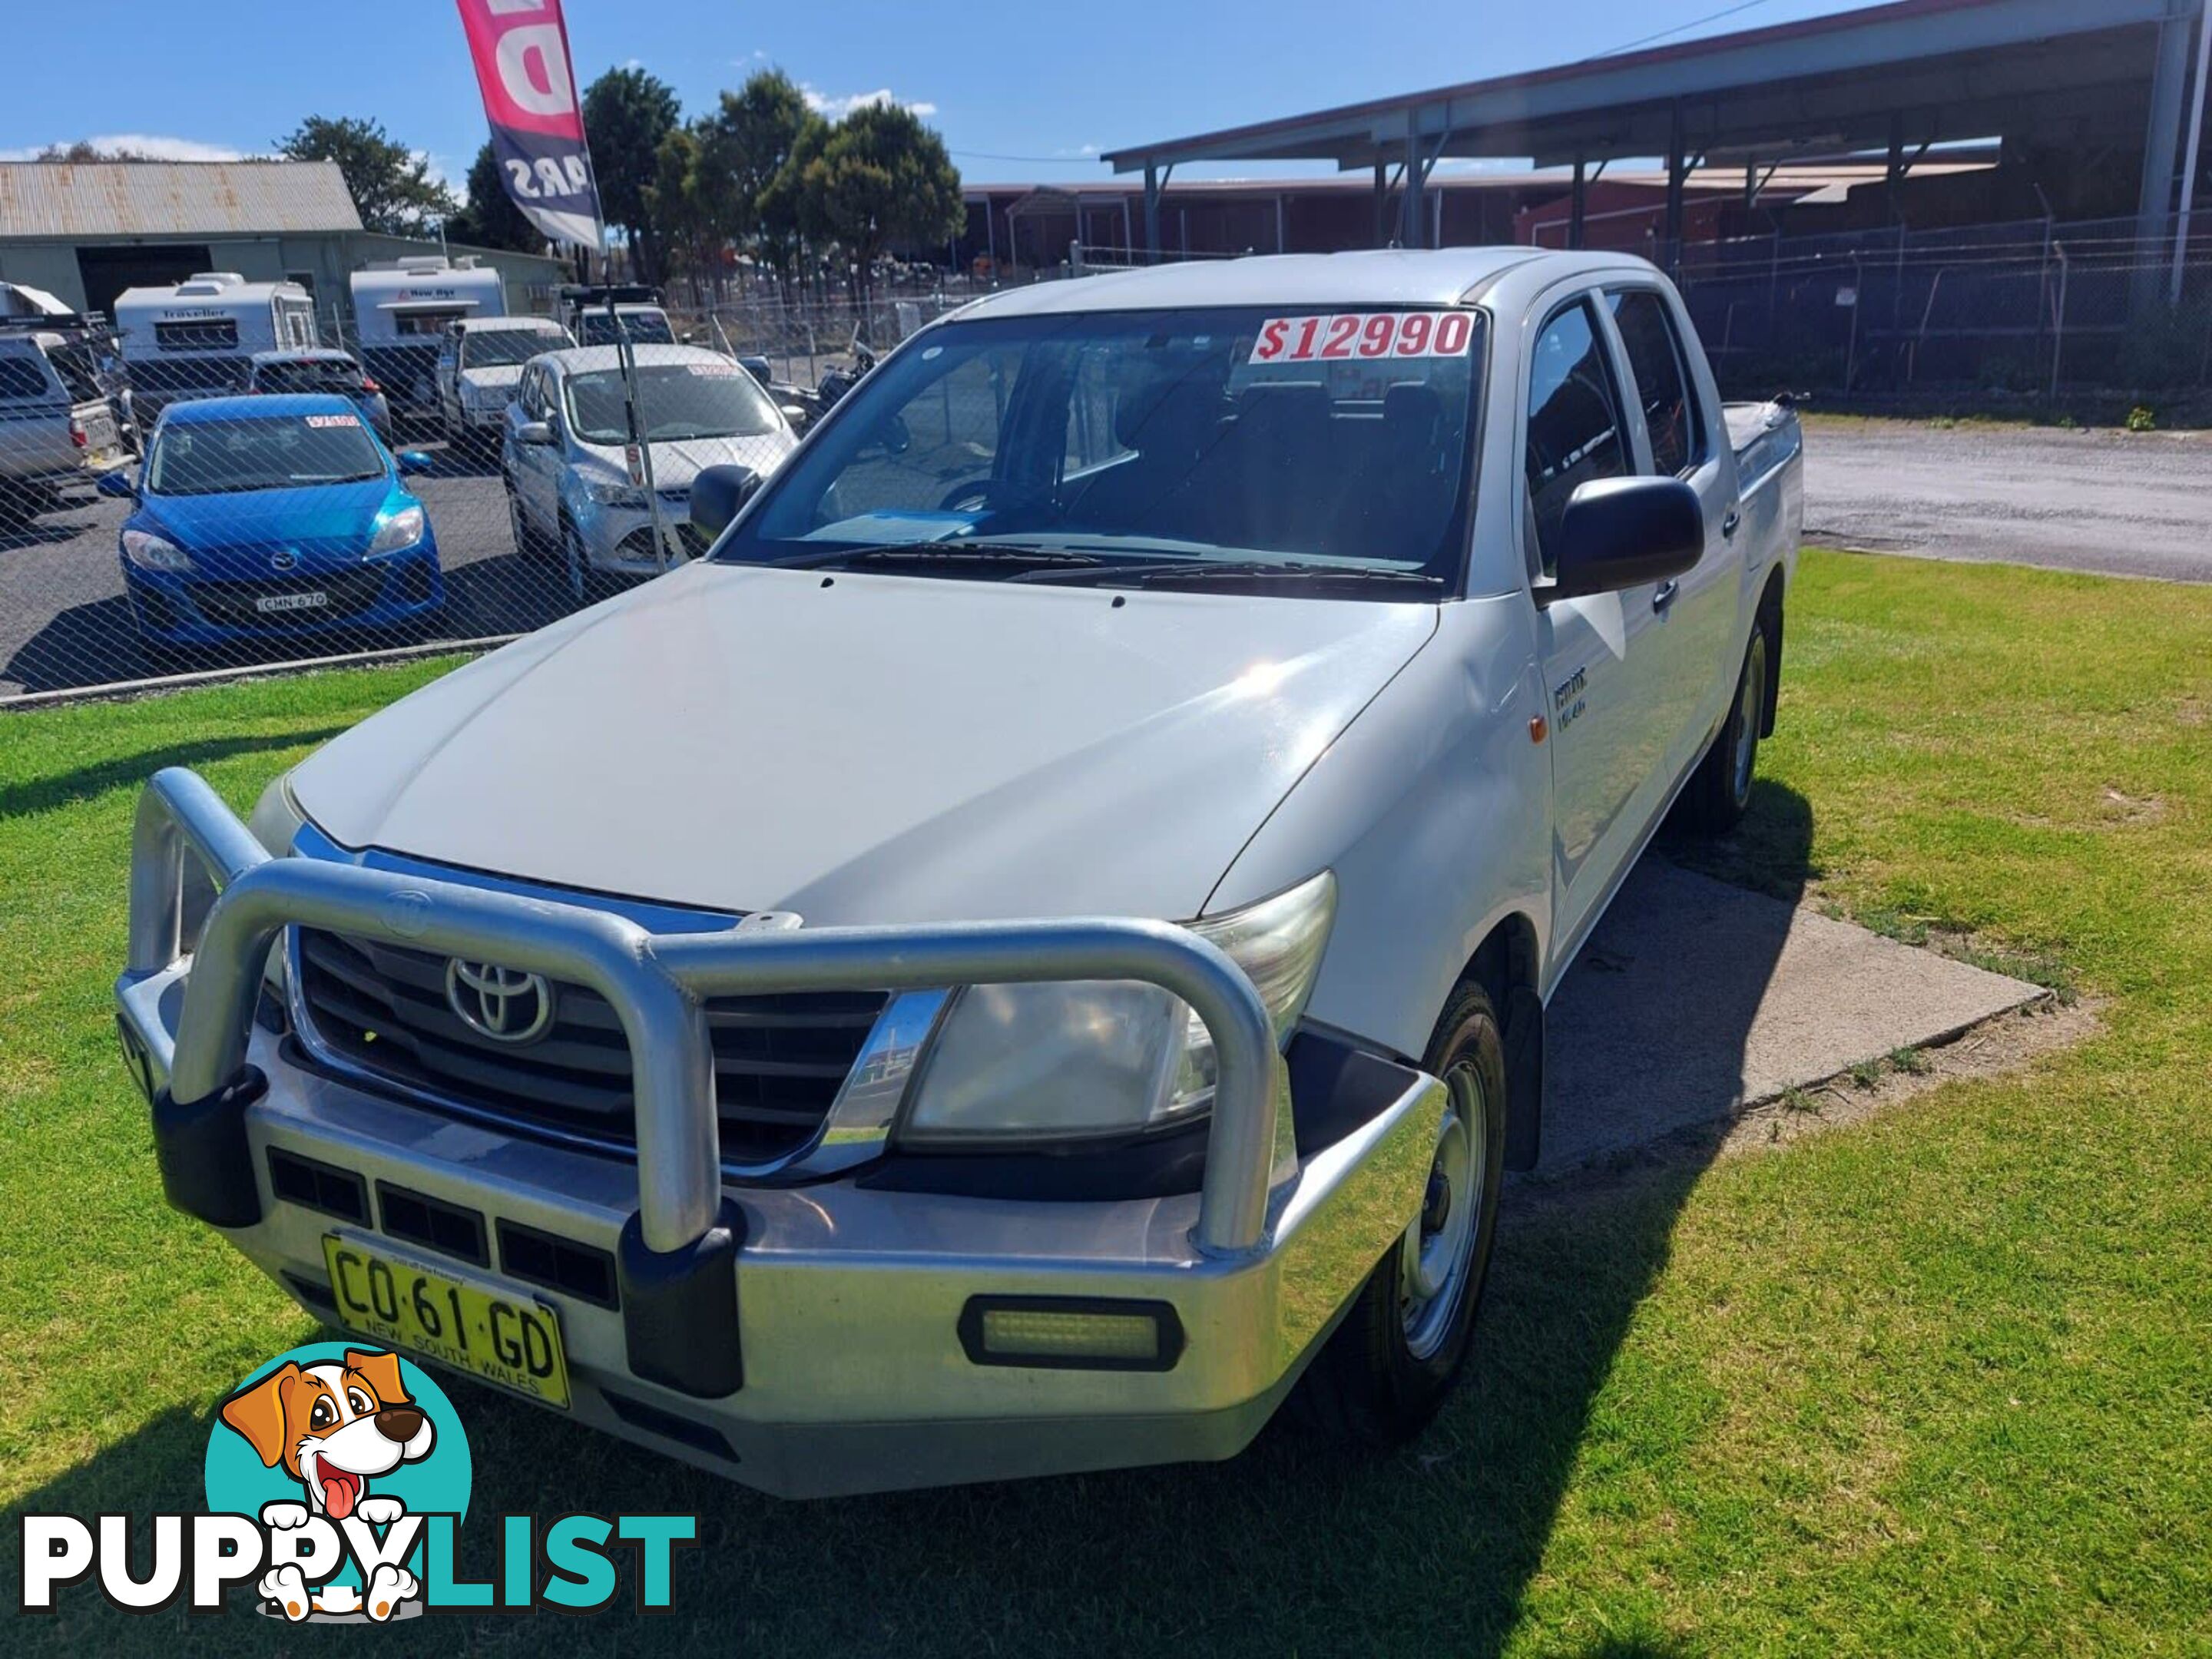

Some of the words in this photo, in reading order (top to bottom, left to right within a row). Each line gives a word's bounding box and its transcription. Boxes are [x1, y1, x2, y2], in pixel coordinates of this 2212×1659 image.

[163, 309, 227, 319] Traveller
[1257, 313, 1471, 360] $12990
[365, 1318, 402, 1342] NEW
[412, 1333, 471, 1368] SOUTH
[481, 1358, 542, 1395] WALES
